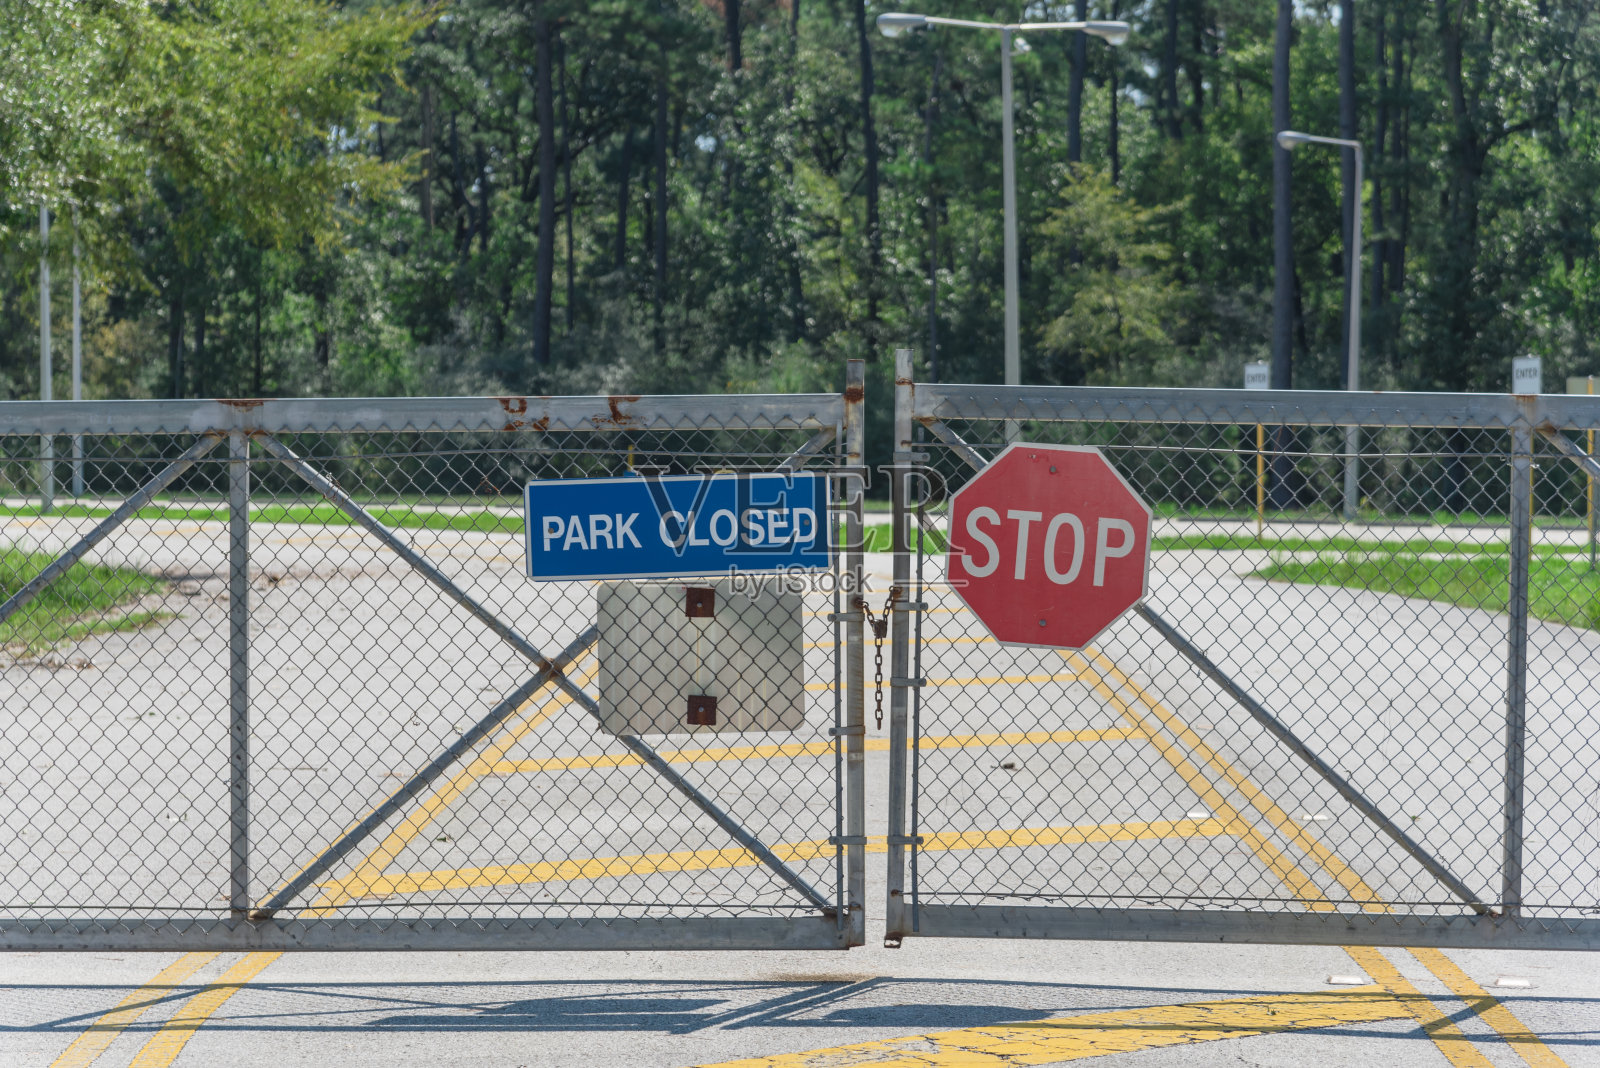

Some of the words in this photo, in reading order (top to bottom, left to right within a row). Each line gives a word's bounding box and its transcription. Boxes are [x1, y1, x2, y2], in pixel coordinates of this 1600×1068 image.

[1515, 367, 1538, 379] ENTER
[542, 512, 642, 552] PARK
[659, 507, 818, 549] CLOSED
[961, 506, 1135, 587] STOP
